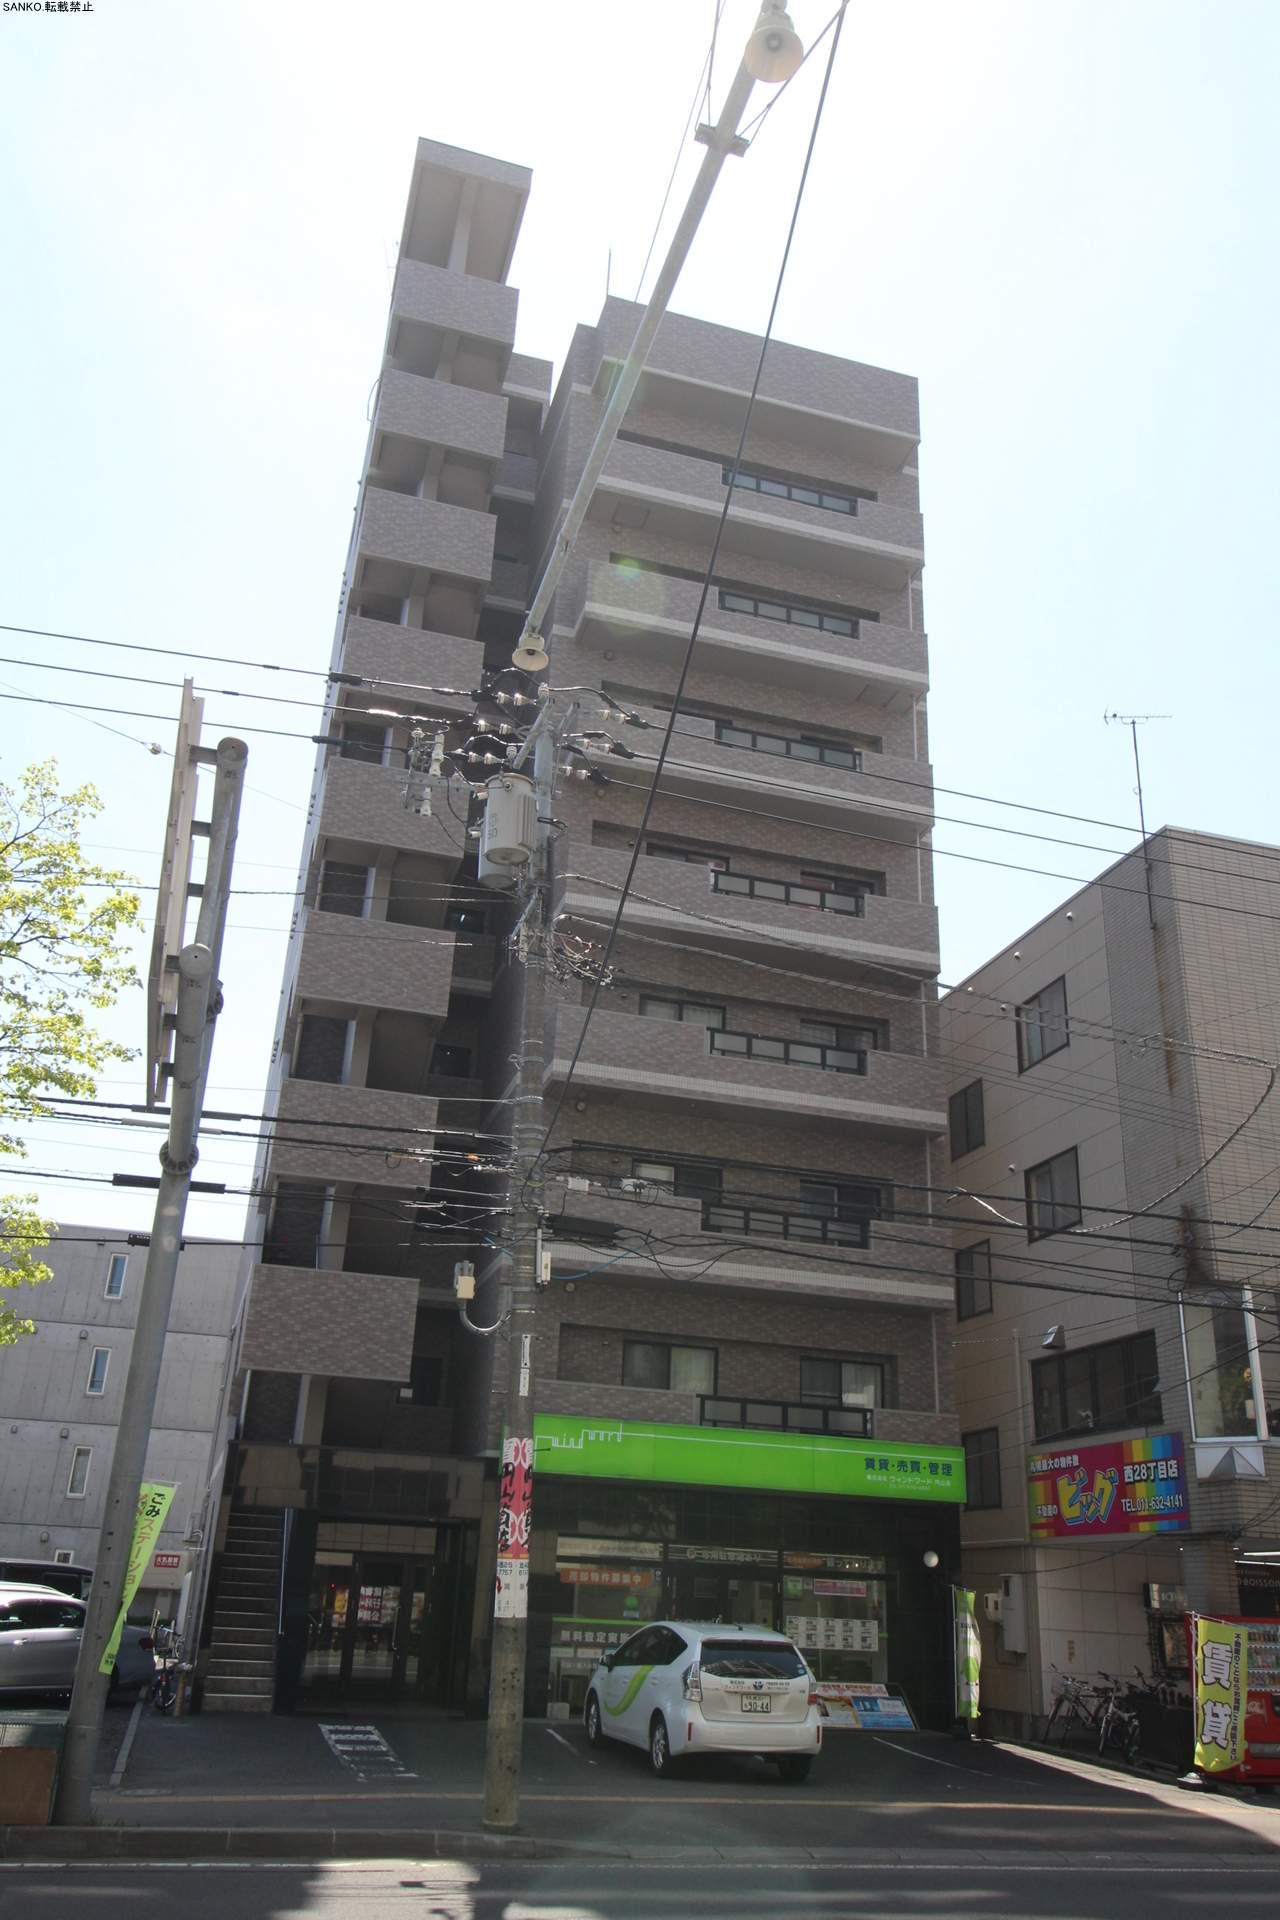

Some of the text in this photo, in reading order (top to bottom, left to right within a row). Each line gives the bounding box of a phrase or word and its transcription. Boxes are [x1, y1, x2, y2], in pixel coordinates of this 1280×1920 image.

[1056, 1467, 1119, 1526] ビッグ
[1124, 1460, 1178, 1483] 西28丁目店
[1202, 1640, 1233, 1750] 賃貸
